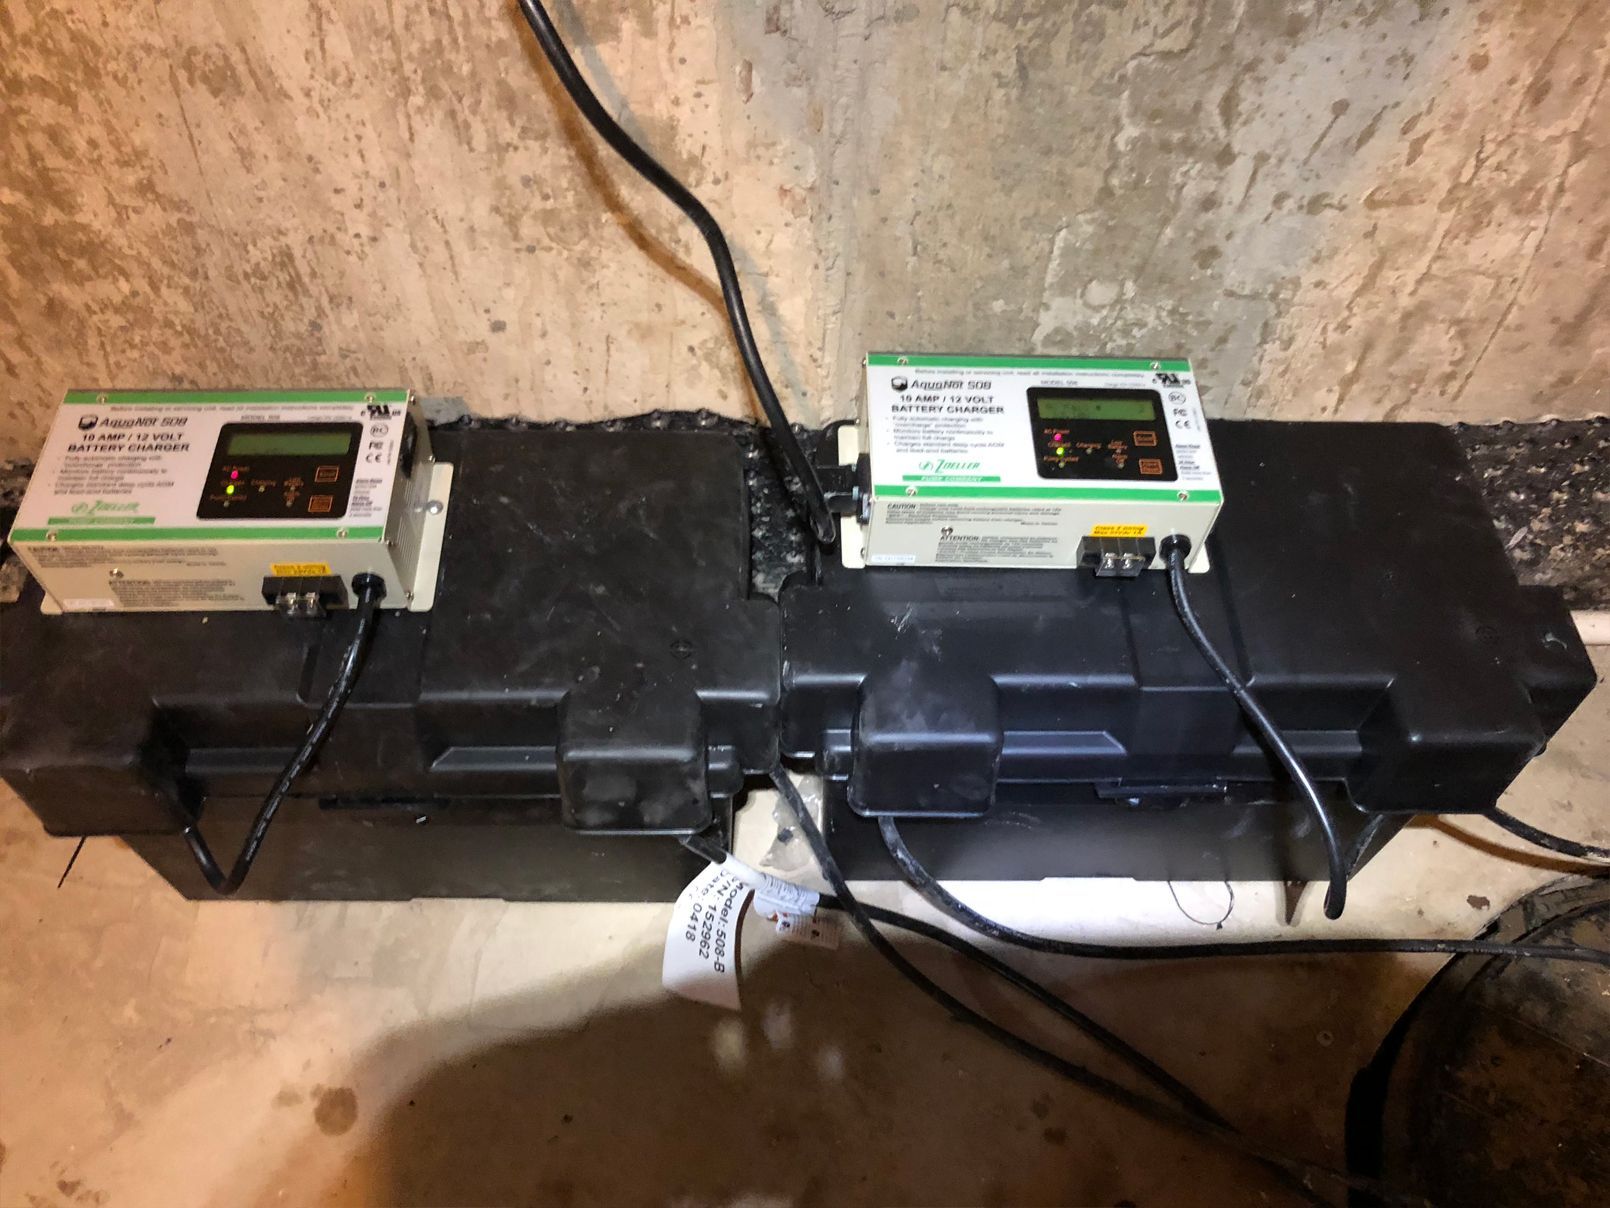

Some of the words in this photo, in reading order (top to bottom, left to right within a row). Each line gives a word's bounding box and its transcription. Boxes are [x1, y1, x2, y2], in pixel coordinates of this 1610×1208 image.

[911, 380, 964, 390] AquaNot
[900, 394, 912, 402] 10
[914, 394, 940, 403] AMP
[964, 396, 994, 404] VOLT
[891, 404, 944, 414] BATTERY
[946, 406, 1004, 414] CHARGER
[82, 434, 96, 442] 10
[98, 434, 126, 442] AMP
[136, 434, 150, 442] 12
[152, 433, 184, 441] VOLT
[67, 444, 125, 452] BATTERY
[128, 444, 190, 452] CHARGER
[685, 902, 702, 942] 0418
[698, 904, 718, 960] 152962
